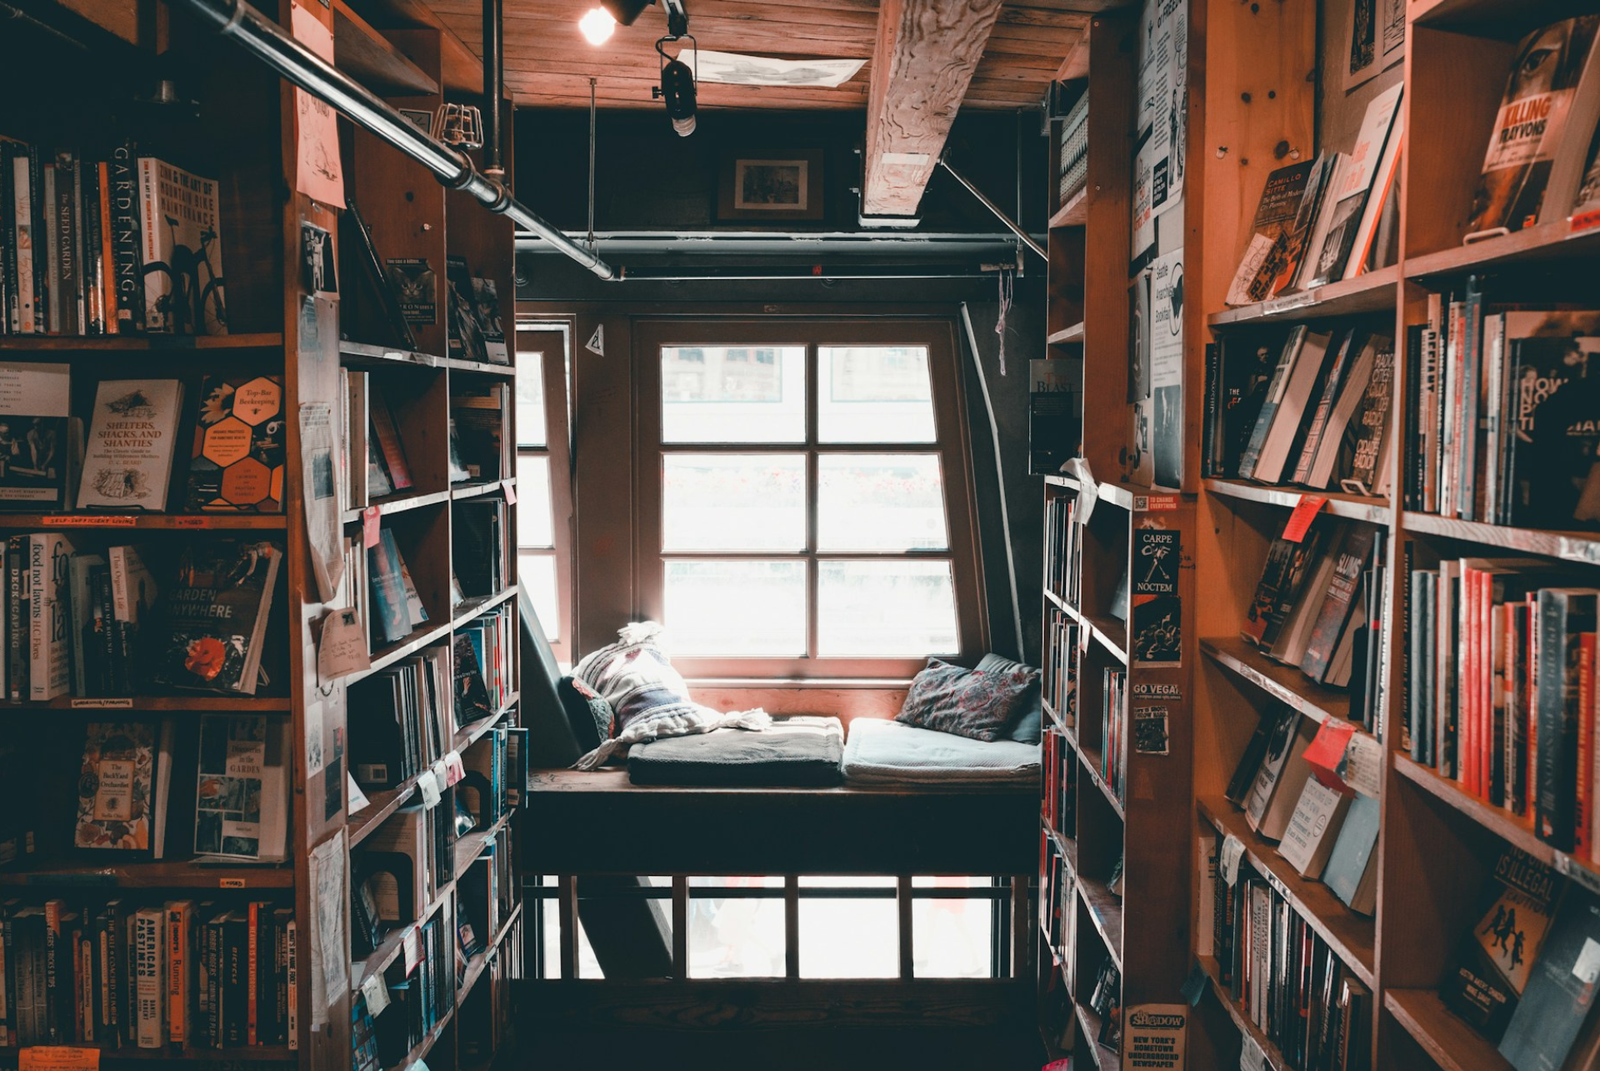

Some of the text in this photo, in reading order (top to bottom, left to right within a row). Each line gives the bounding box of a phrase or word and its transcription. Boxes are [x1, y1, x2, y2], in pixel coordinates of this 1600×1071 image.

[1503, 96, 1552, 128] KILLING
[1499, 118, 1547, 144] TRAYVONS
[180, 173, 189, 189] THE
[204, 182, 213, 195] OF
[1266, 184, 1286, 194] SITTE
[1268, 174, 1301, 187] CAMILLO
[161, 198, 214, 227] MAINTENANCE
[195, 195, 214, 211] BIKE
[61, 206, 71, 233] SEED
[115, 147, 135, 292] GARDENING
[62, 236, 71, 280] GARDEN
[1156, 307, 1171, 323] Bookfair
[1428, 332, 1436, 393] DEFIANT
[246, 390, 272, 398] Top-Bar
[1520, 391, 1549, 405] NO
[98, 430, 162, 439] SHACKS, AND
[106, 422, 155, 430] SHELTERS,
[1142, 534, 1173, 544] CARPE
[32, 544, 44, 567] food
[1336, 553, 1362, 579] SLUMS
[33, 570, 43, 587] not
[1137, 582, 1173, 593] NOCTEM
[11, 569, 20, 649] DECKSCAPING
[33, 589, 44, 618] lawns
[33, 638, 42, 660] Flores
[1133, 684, 1147, 694] GO
[230, 765, 260, 774] GARDEN
[1496, 854, 1554, 901] IS ILLEGAL
[138, 918, 146, 976] PASTIMES
[147, 919, 155, 977] AMERICAN
[172, 960, 181, 995] Running
[1128, 1052, 1179, 1061] UNDERGROUND
[1134, 1044, 1174, 1052] HOMETOWN
